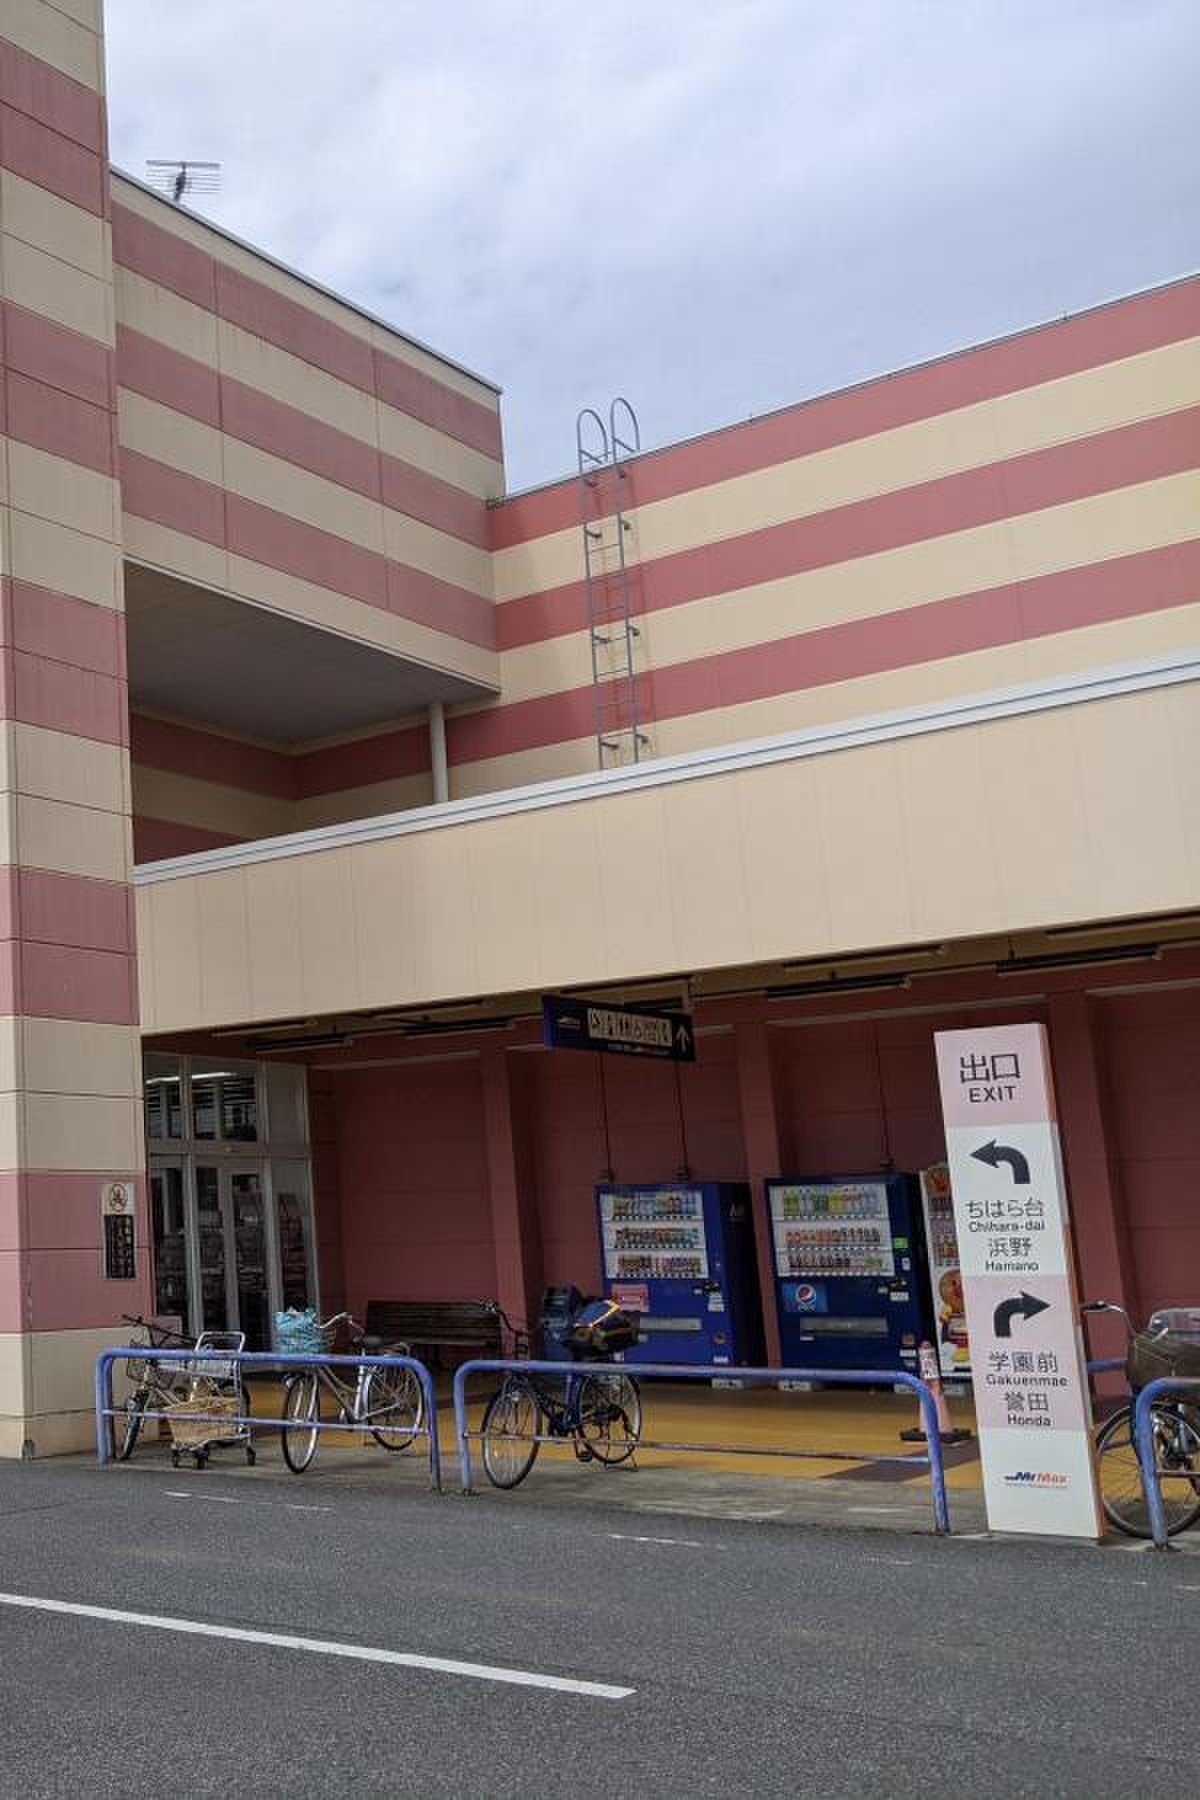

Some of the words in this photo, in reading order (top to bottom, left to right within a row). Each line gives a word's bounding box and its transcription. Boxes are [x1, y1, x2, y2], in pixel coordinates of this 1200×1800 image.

[960, 1053, 1020, 1083] 出口
[969, 1086, 1016, 1103] EXIT
[964, 1197, 1044, 1219] ちはら台
[968, 1220, 1045, 1233] Chihara-dai
[988, 1237, 1032, 1257] 浜野
[985, 1260, 1039, 1272] Hamano
[988, 1351, 1058, 1373] 学園前
[984, 1374, 1068, 1387] Gakuenmae
[1007, 1413, 1051, 1426] Honda
